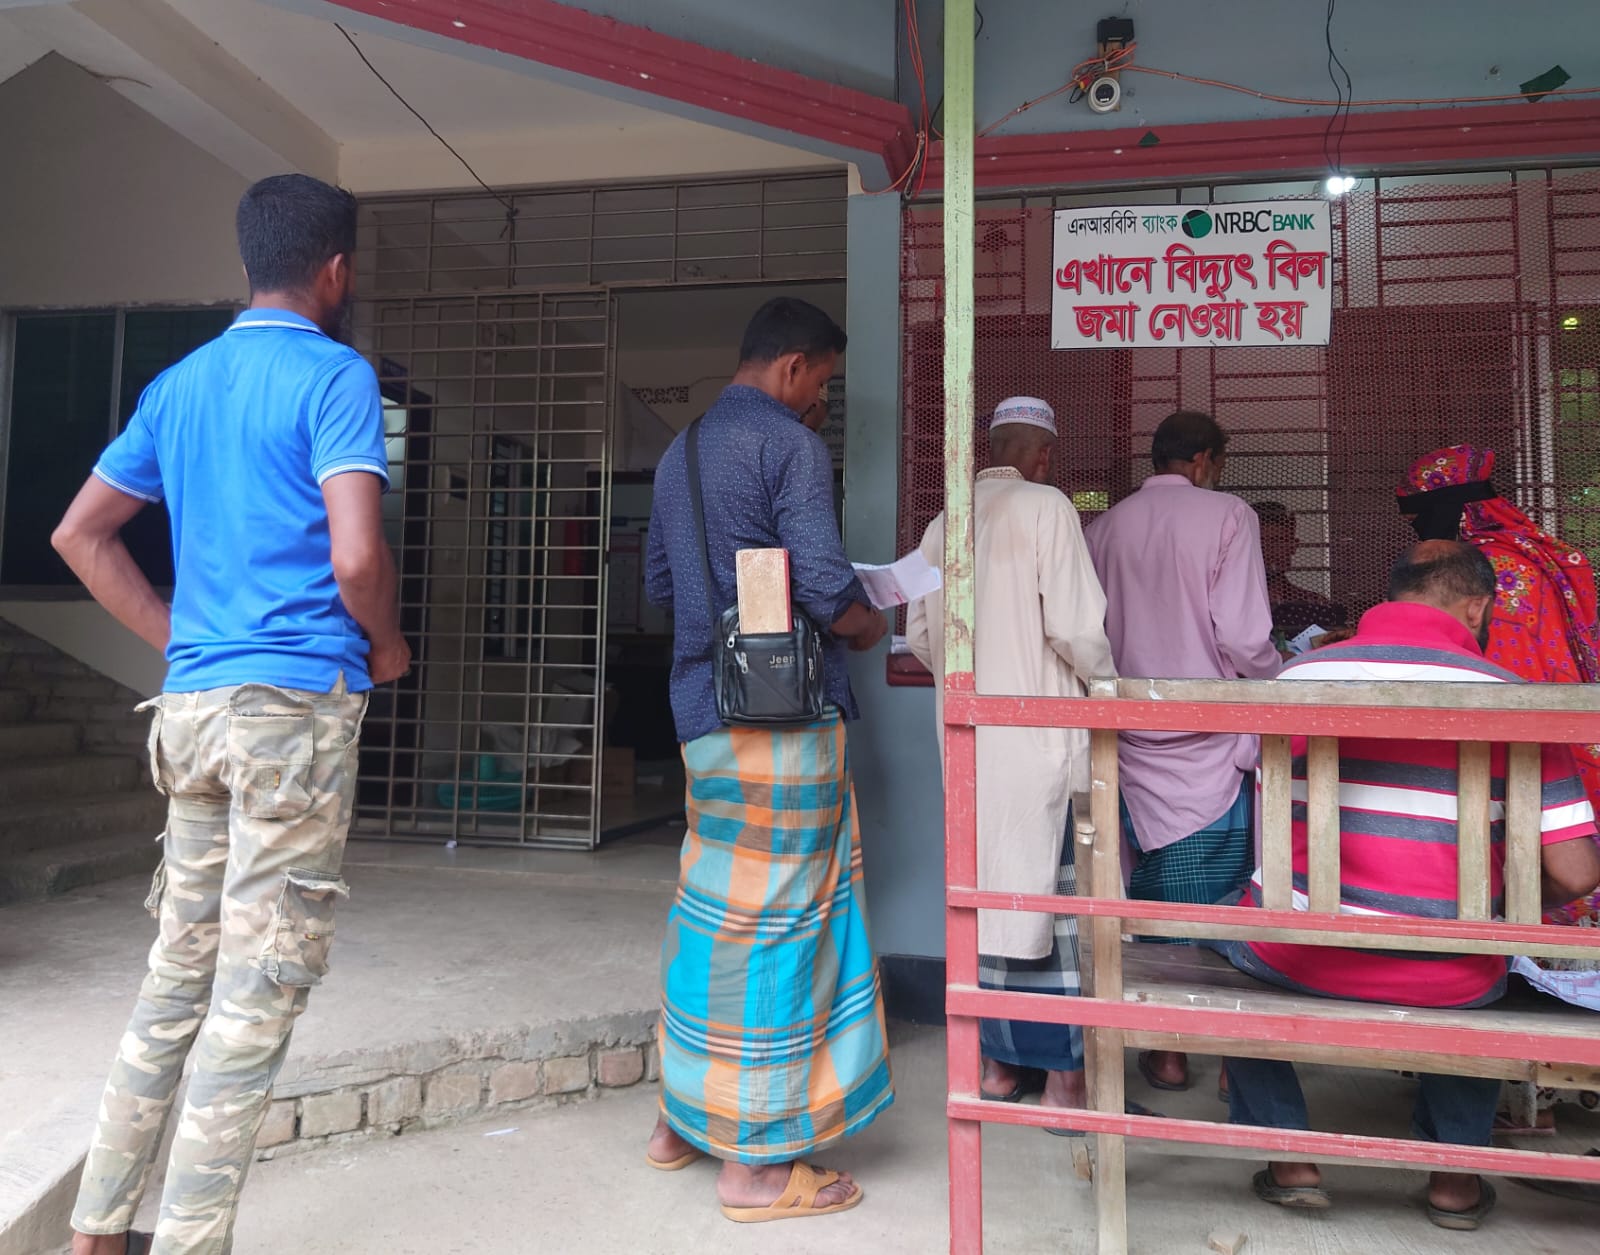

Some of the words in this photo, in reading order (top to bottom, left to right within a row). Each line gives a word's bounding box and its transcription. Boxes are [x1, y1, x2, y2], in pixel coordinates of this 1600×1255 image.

[1067, 210, 1137, 236] এনআরবিসি
[1141, 212, 1179, 235] ব্যাংক
[1215, 209, 1272, 235] NRBC
[1272, 213, 1315, 232] BANK
[1056, 253, 1156, 295] এখানে
[1162, 243, 1257, 301] বিদ্যুৎ
[1263, 239, 1329, 290] বিল
[1073, 301, 1141, 342] জমা
[1149, 299, 1247, 341] নেওয়া
[1254, 301, 1308, 340] হয়
[769, 655, 796, 665] Jeep
